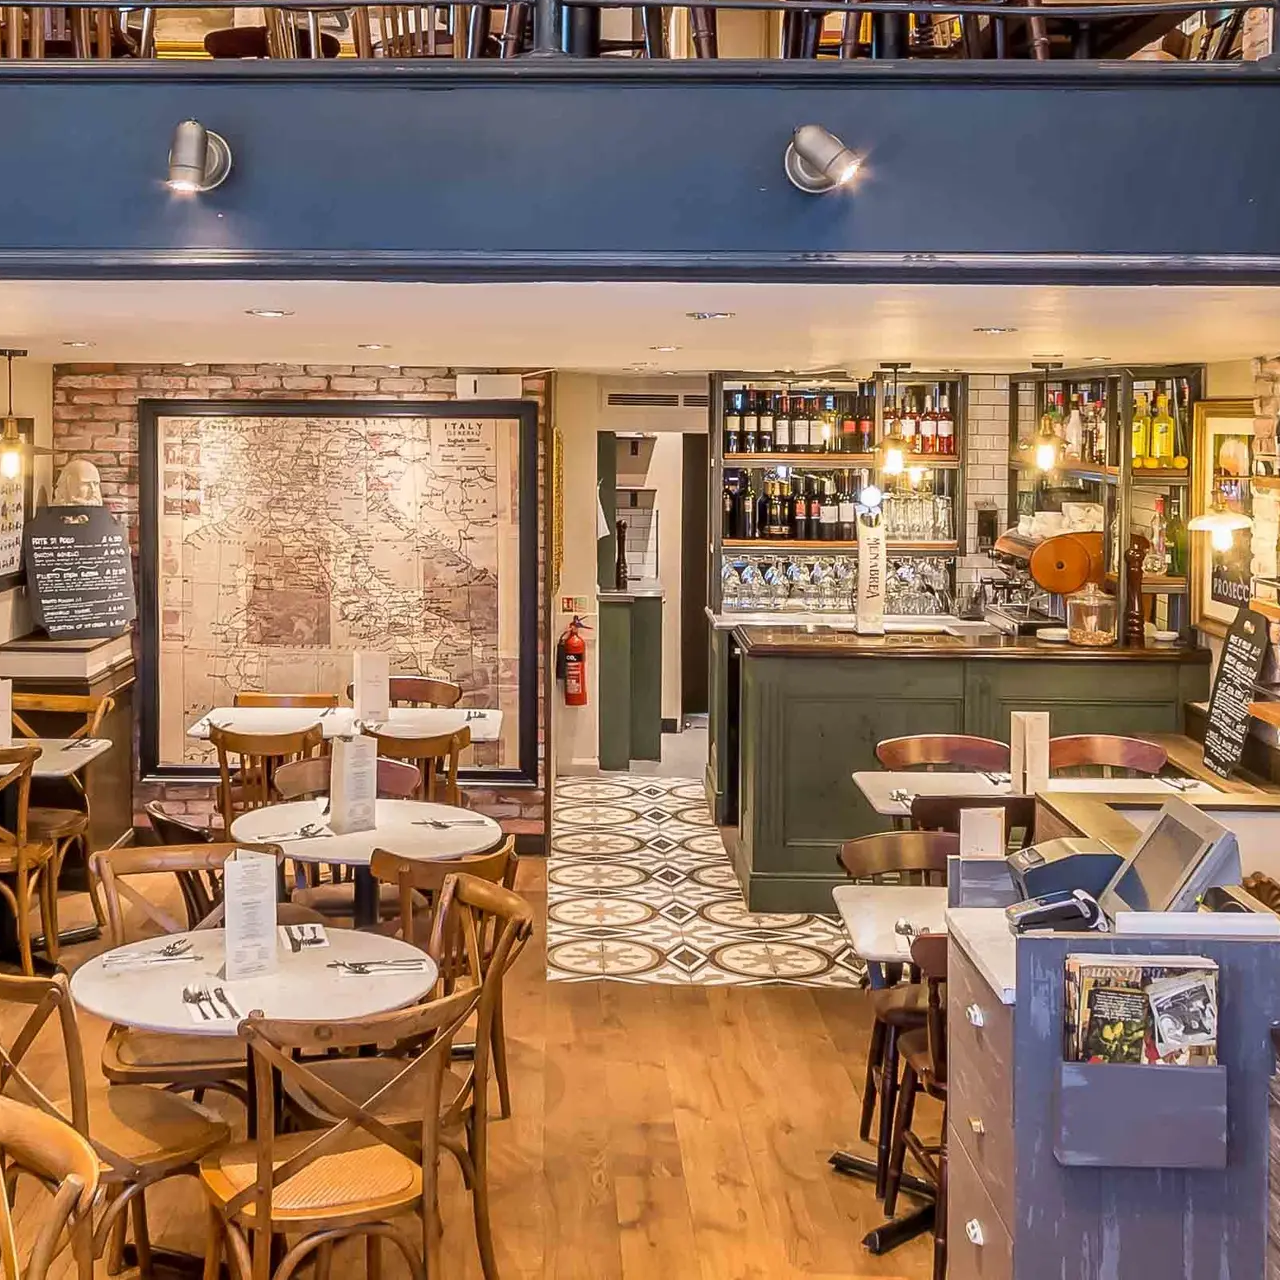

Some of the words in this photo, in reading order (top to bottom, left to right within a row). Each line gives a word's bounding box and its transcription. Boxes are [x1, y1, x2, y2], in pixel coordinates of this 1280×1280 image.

[444, 422, 483, 430] ITALY
[866, 536, 881, 600] MENABREA
[1213, 577, 1250, 603] PROSECC
